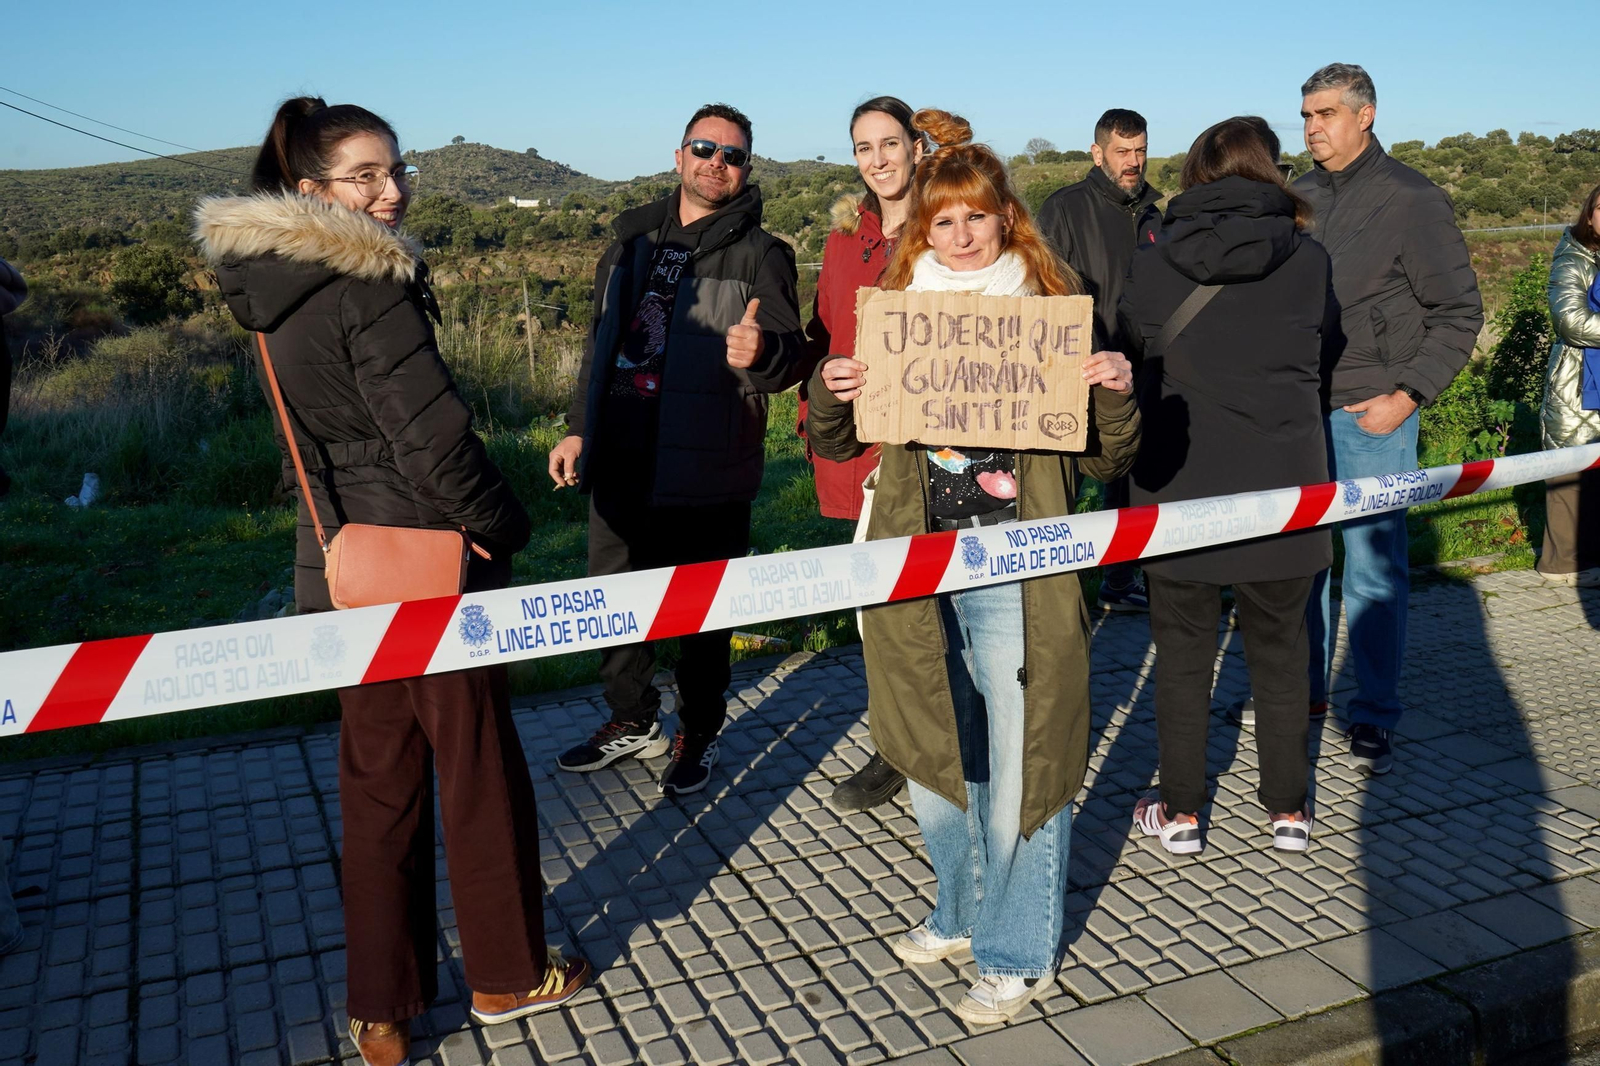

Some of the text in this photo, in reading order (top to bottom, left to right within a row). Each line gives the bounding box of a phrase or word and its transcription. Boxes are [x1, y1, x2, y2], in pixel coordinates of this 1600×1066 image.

[1029, 317, 1083, 363] QUE
[901, 356, 1048, 395] GUARRADA
[1047, 419, 1073, 431] ROBE
[1375, 470, 1429, 488] NO PASAR
[1361, 483, 1443, 512] LINEA DE POLICIA
[1005, 522, 1073, 548] NO PASAR
[990, 541, 1095, 577] LINEA DE POLICIA
[521, 588, 607, 621] NO PASAR
[496, 611, 639, 654] LINEA DE POLICIA
[469, 649, 491, 658] D.G.P.
